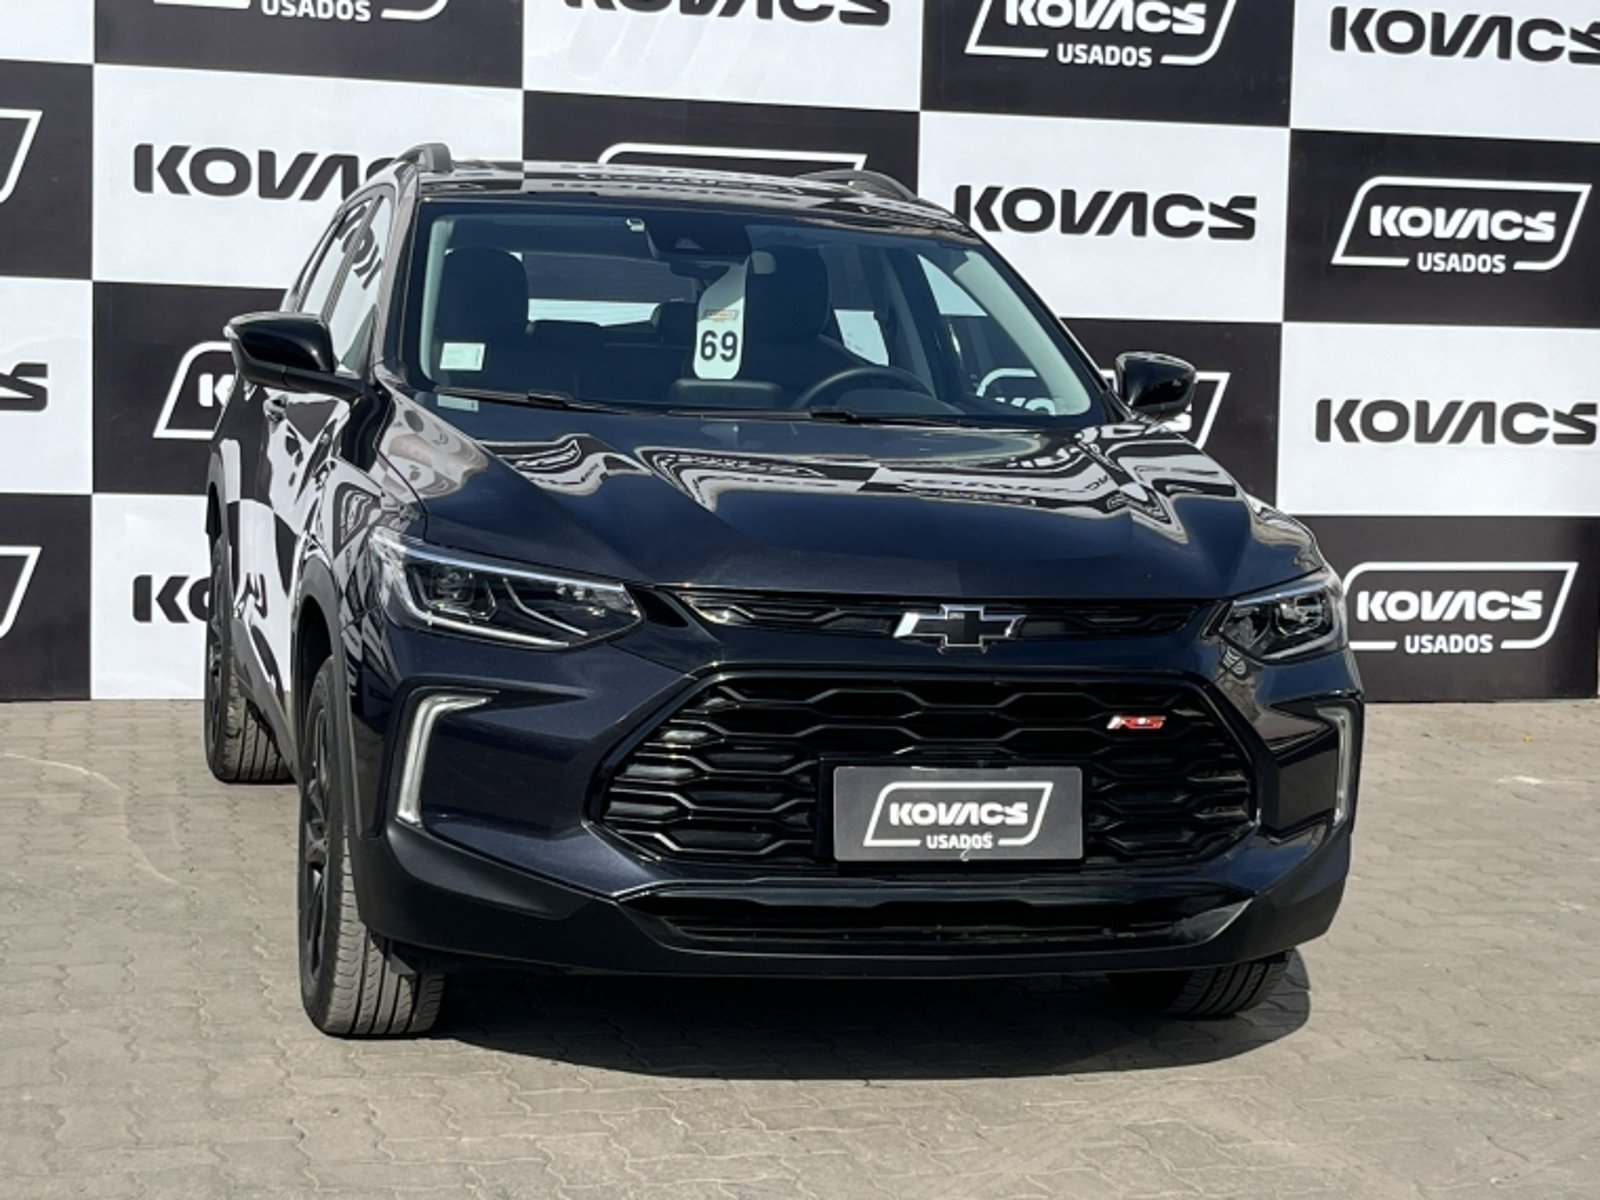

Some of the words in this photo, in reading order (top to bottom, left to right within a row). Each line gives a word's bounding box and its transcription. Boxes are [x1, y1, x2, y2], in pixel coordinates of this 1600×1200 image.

[261, 0, 372, 22] USADOS
[1005, 0, 1207, 35] KOVACS
[1330, 6, 1600, 65] KOVACS
[1056, 42, 1153, 68] USADOS
[133, 143, 399, 202] KOVA
[955, 184, 1257, 241] KOVACS
[1369, 205, 1557, 242] KOVACS
[1416, 252, 1507, 274] USADOS
[700, 329, 738, 362] 69
[1315, 398, 1598, 445] KOVACS
[1356, 590, 1544, 622] KOVACS
[1404, 633, 1494, 654] USADOS
[889, 802, 1029, 826] KOVACS
[925, 833, 994, 850] USADOS
